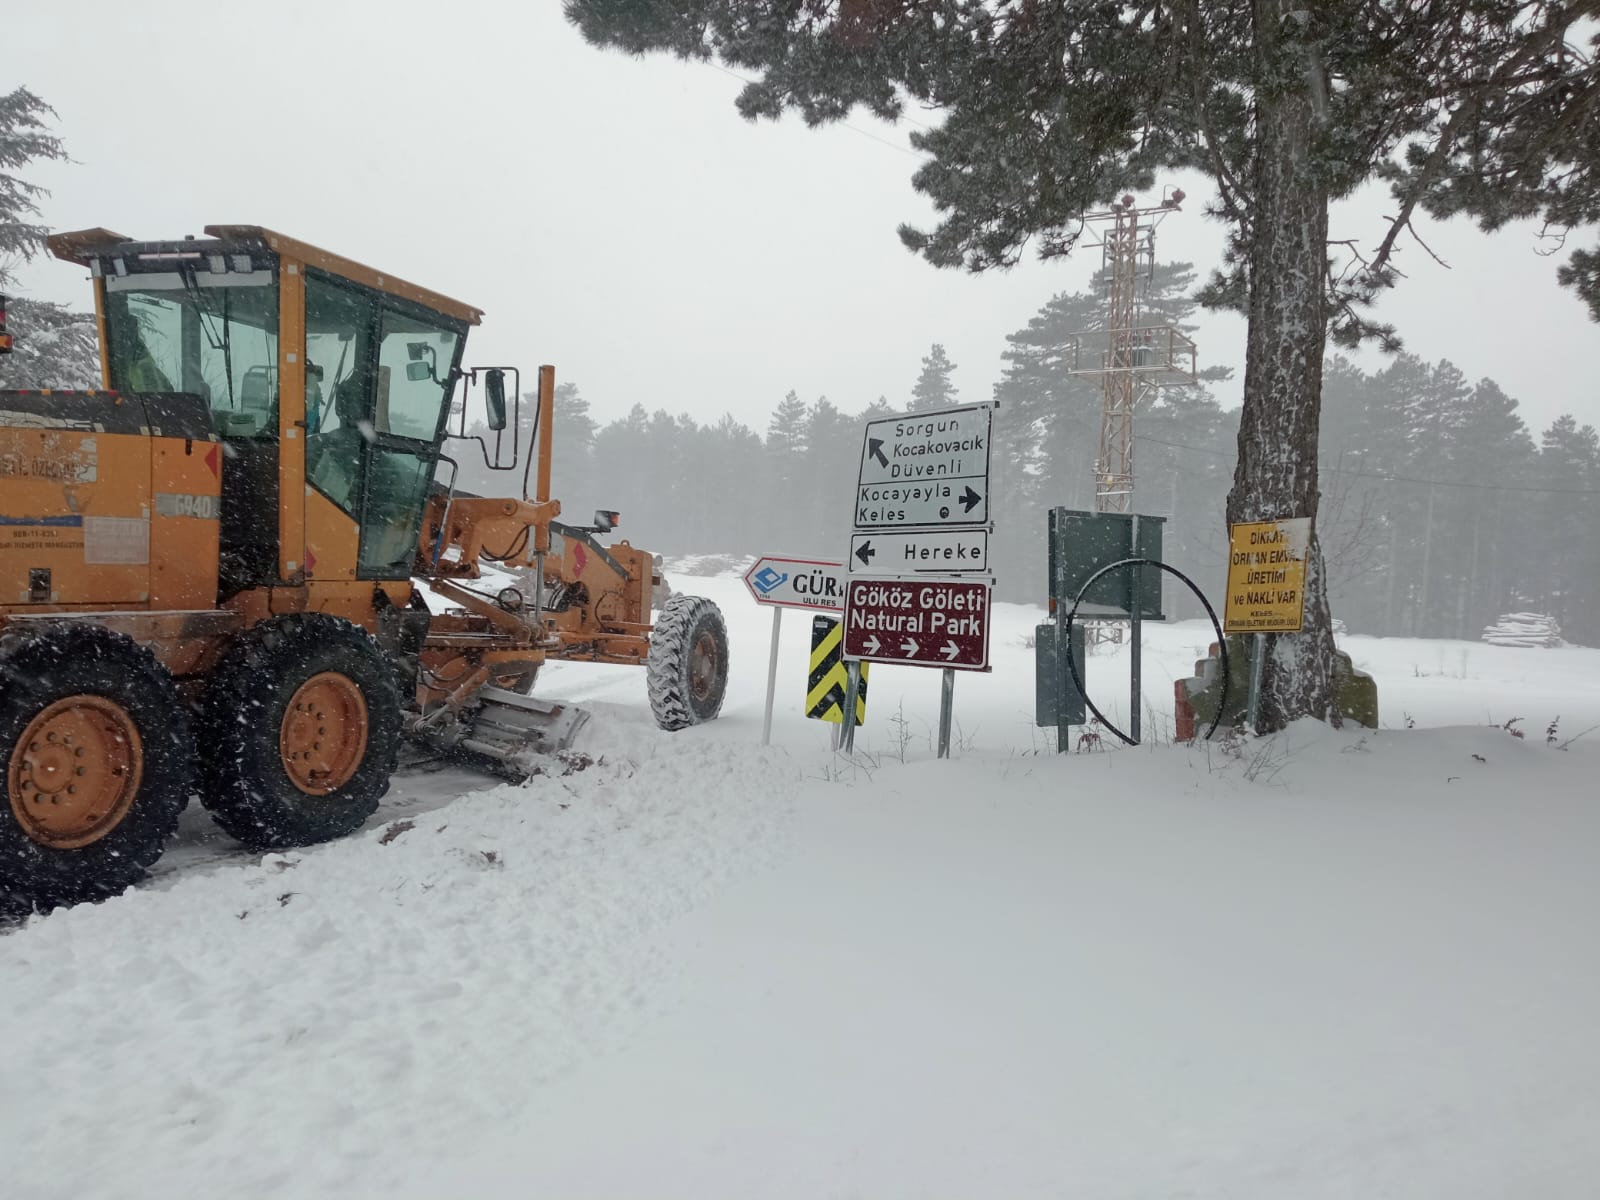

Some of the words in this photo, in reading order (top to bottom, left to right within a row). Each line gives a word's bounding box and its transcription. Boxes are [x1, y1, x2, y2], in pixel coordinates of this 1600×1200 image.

[895, 419, 959, 437] Sorgun
[893, 435, 984, 458] Kocakovacık
[891, 459, 962, 478] Düvenli
[861, 483, 951, 503] Kocayayla
[175, 494, 211, 518] G940
[859, 507, 905, 522] Keles
[904, 543, 981, 560] Hereke
[1247, 567, 1286, 585] ÜRETİMİ
[803, 597, 819, 605] ULU
[853, 585, 913, 608] Gököz
[919, 587, 982, 611] Göleti
[1234, 595, 1245, 606] ve
[1246, 588, 1275, 605] NAKLİ
[1277, 590, 1296, 604] VAR
[850, 608, 924, 633] Natural
[930, 612, 981, 637] Park
